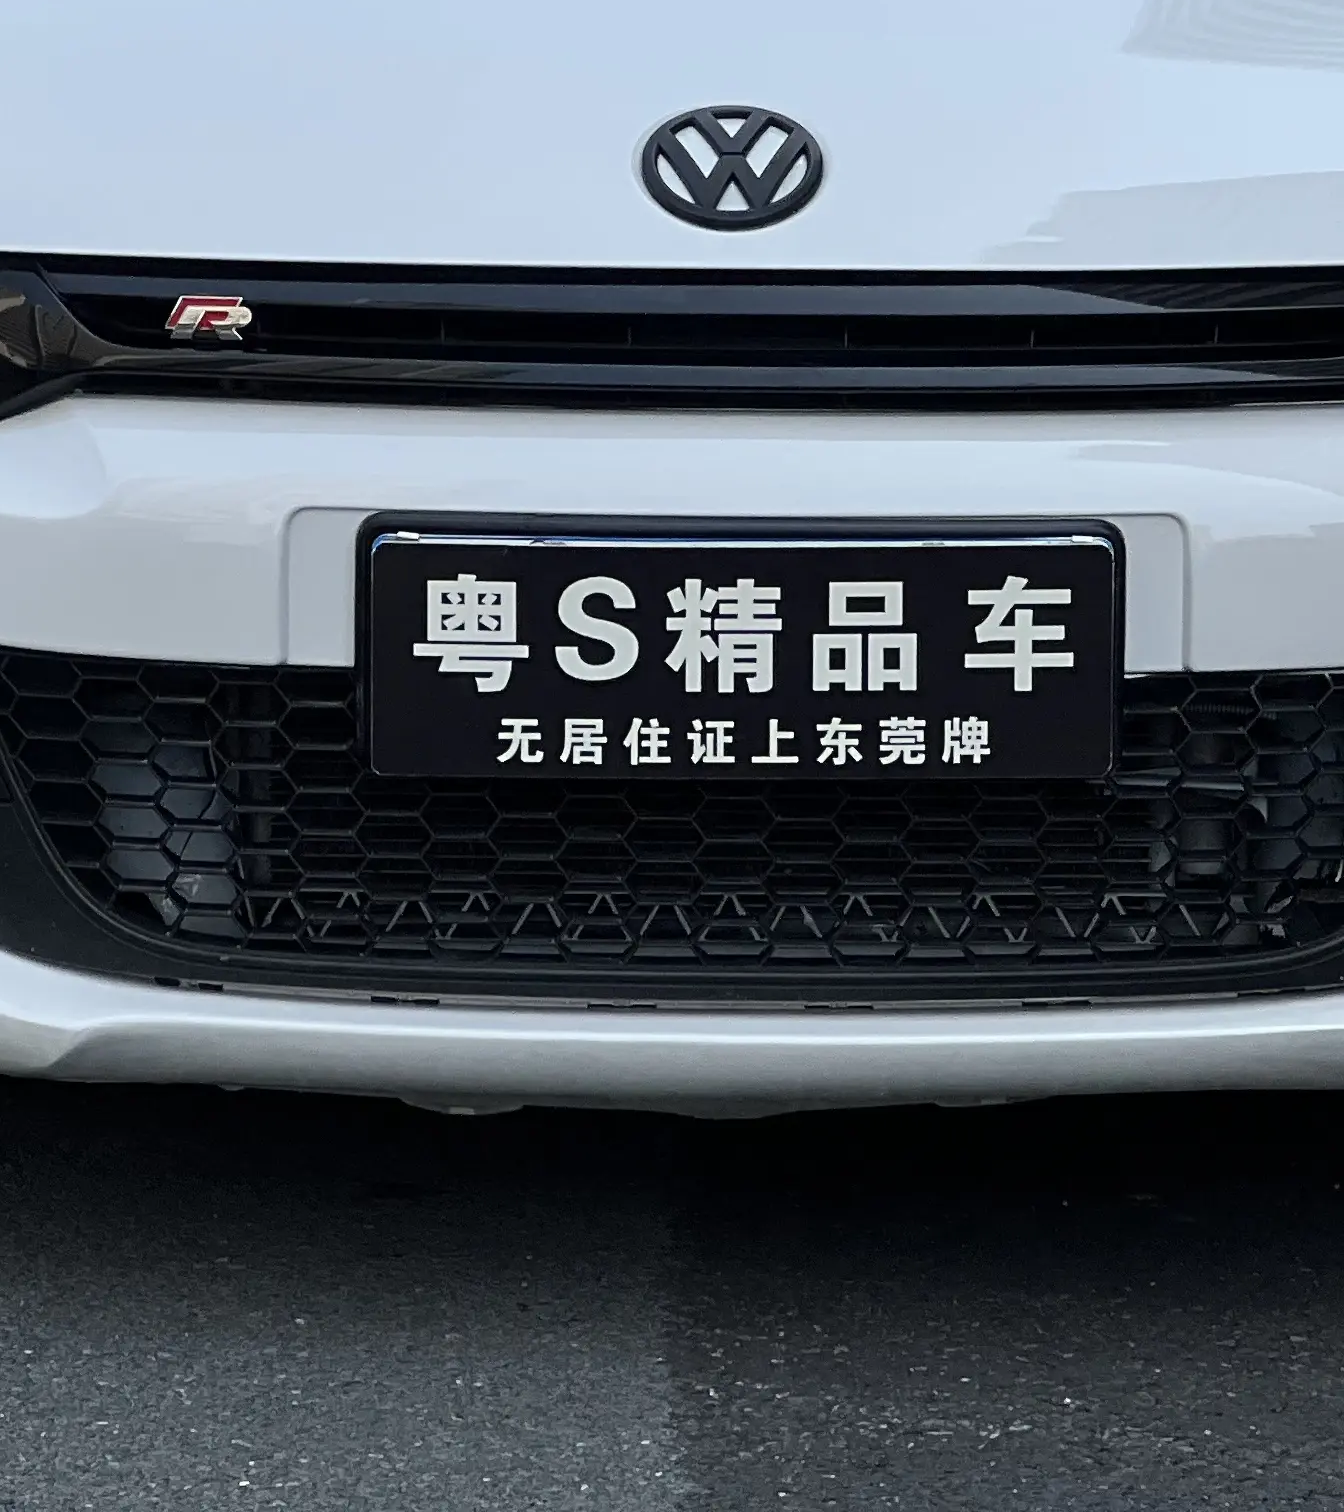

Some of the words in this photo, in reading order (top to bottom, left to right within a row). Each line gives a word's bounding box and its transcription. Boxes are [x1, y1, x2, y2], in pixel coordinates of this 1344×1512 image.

[646, 107, 817, 226] VW
[164, 295, 253, 340] R
[412, 573, 1075, 694] 粤S精品车
[496, 715, 992, 766] 无居住证上东莞牌
